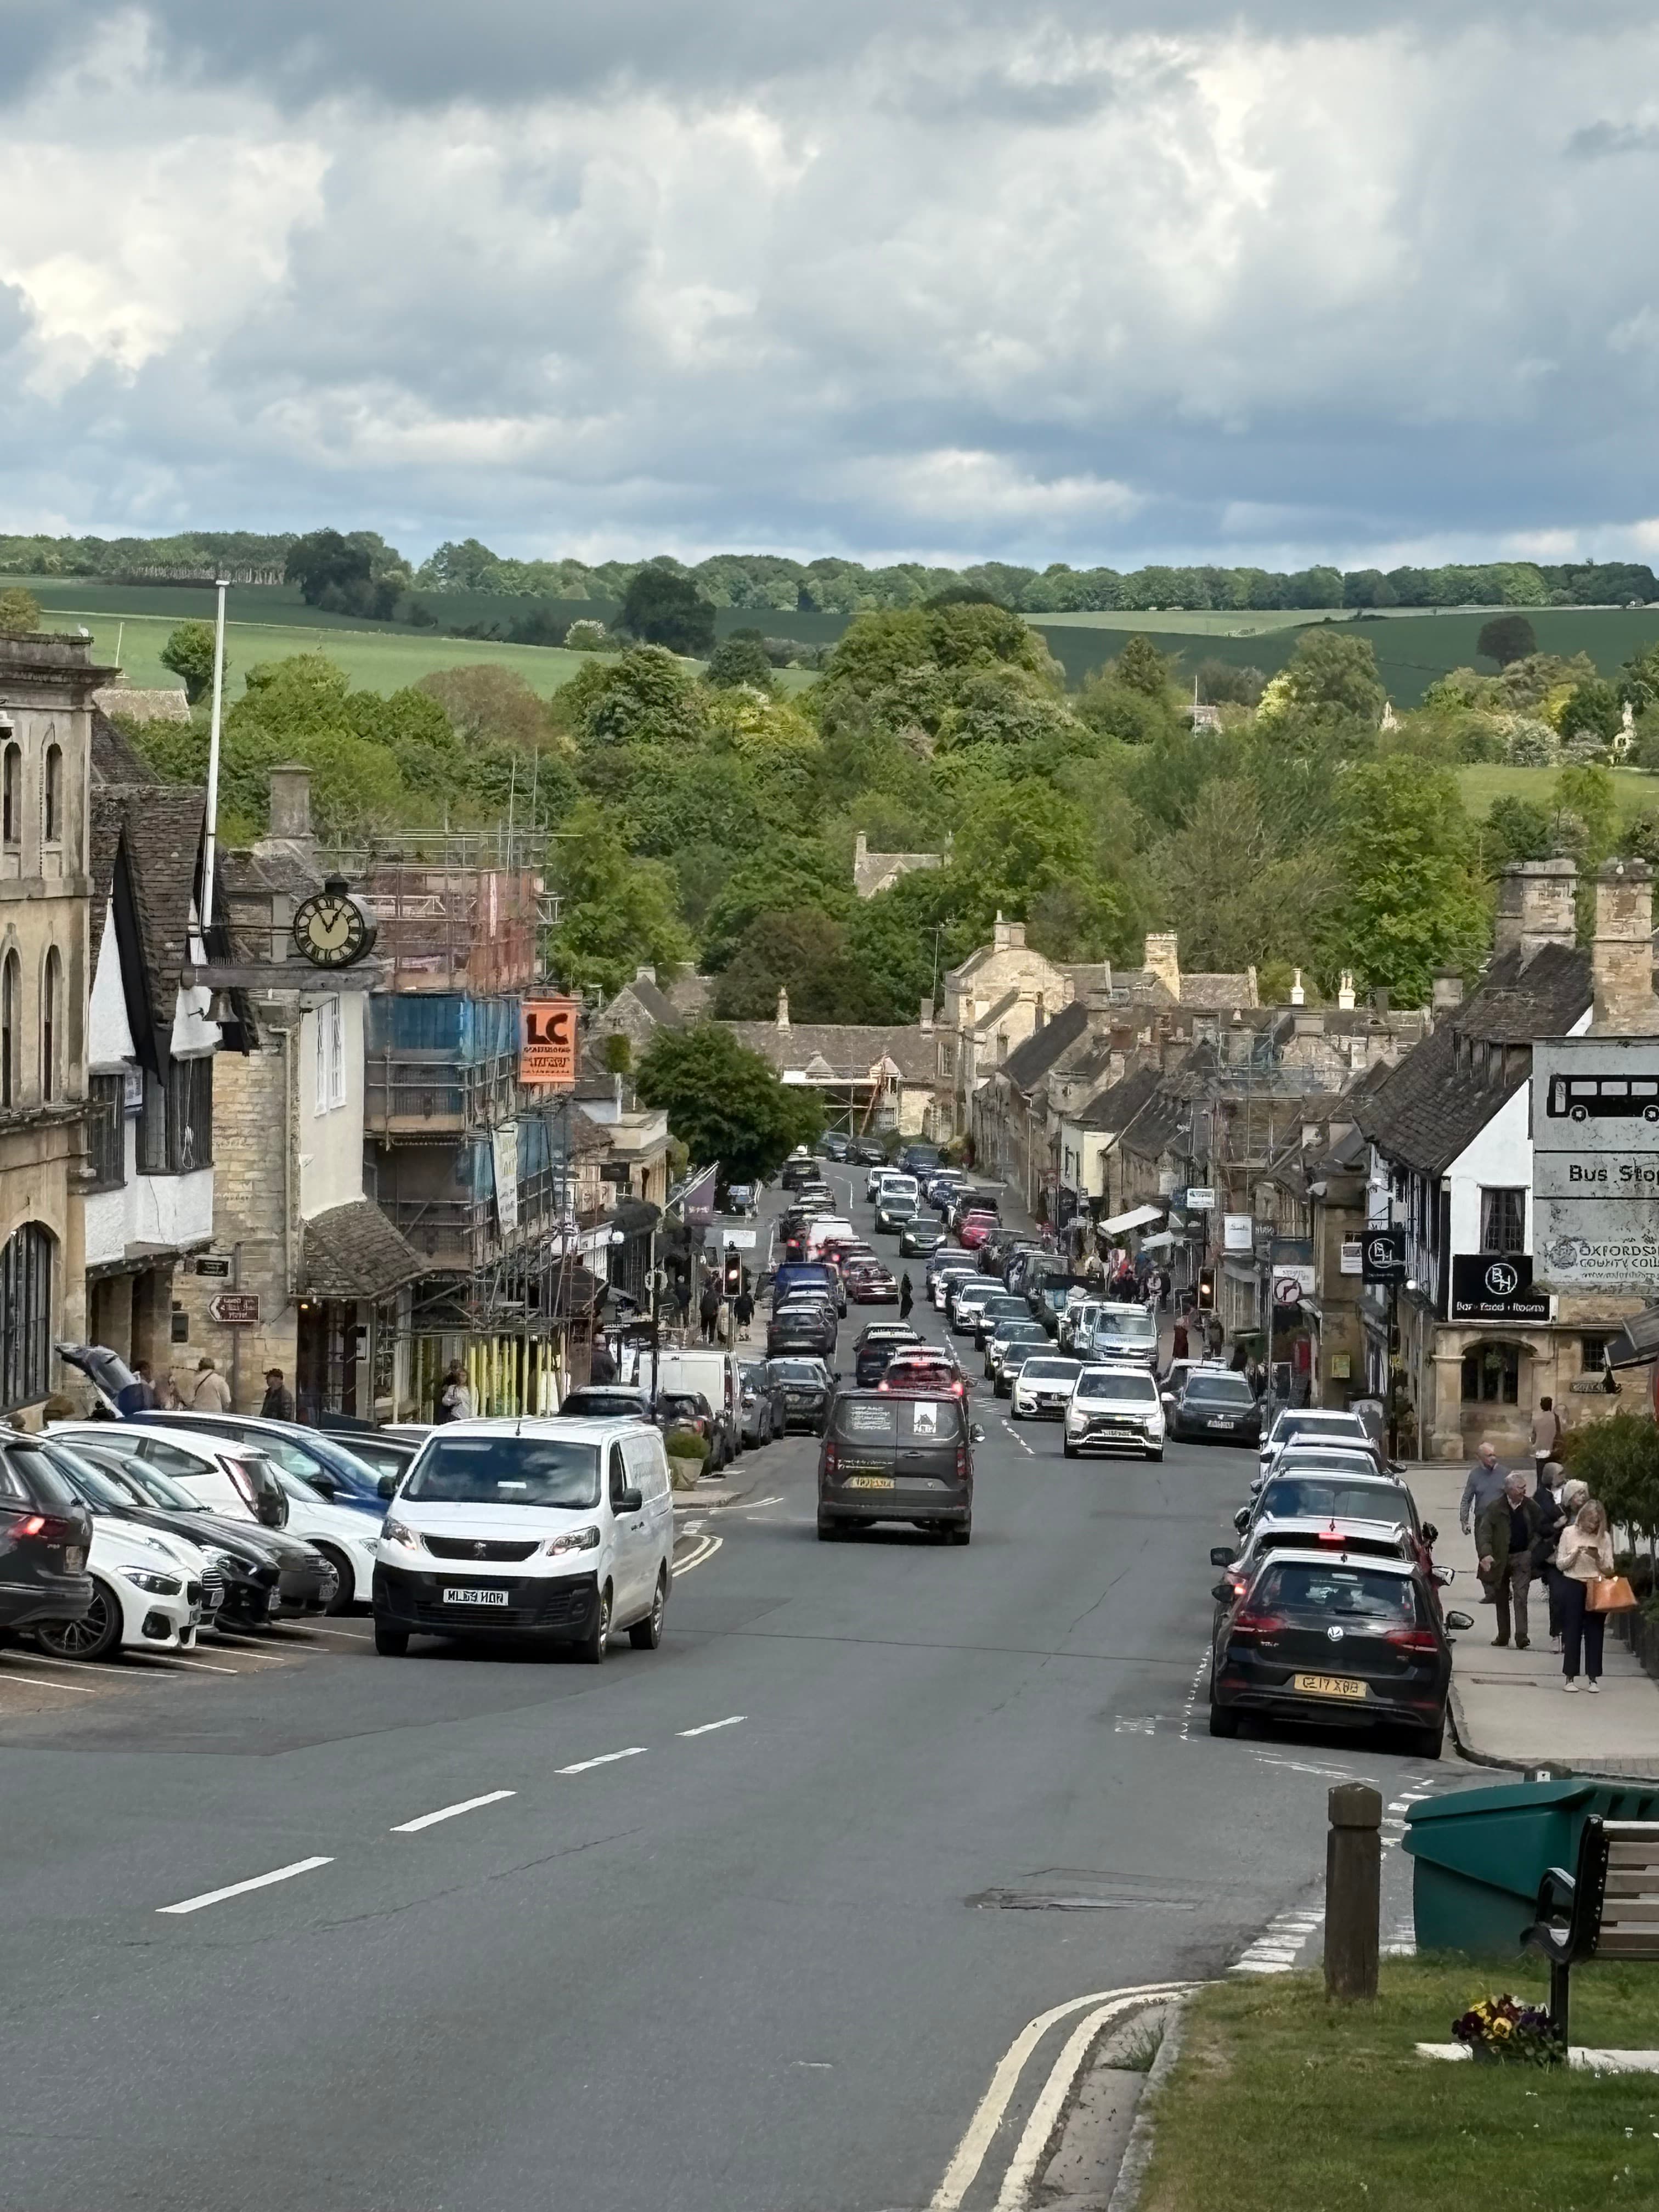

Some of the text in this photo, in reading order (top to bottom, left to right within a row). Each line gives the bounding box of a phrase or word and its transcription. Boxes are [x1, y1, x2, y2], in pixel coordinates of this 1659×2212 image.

[527, 1013, 569, 1045] LC
[1569, 1165, 1608, 1181] Bus
[1632, 1259, 1659, 1268] COU
